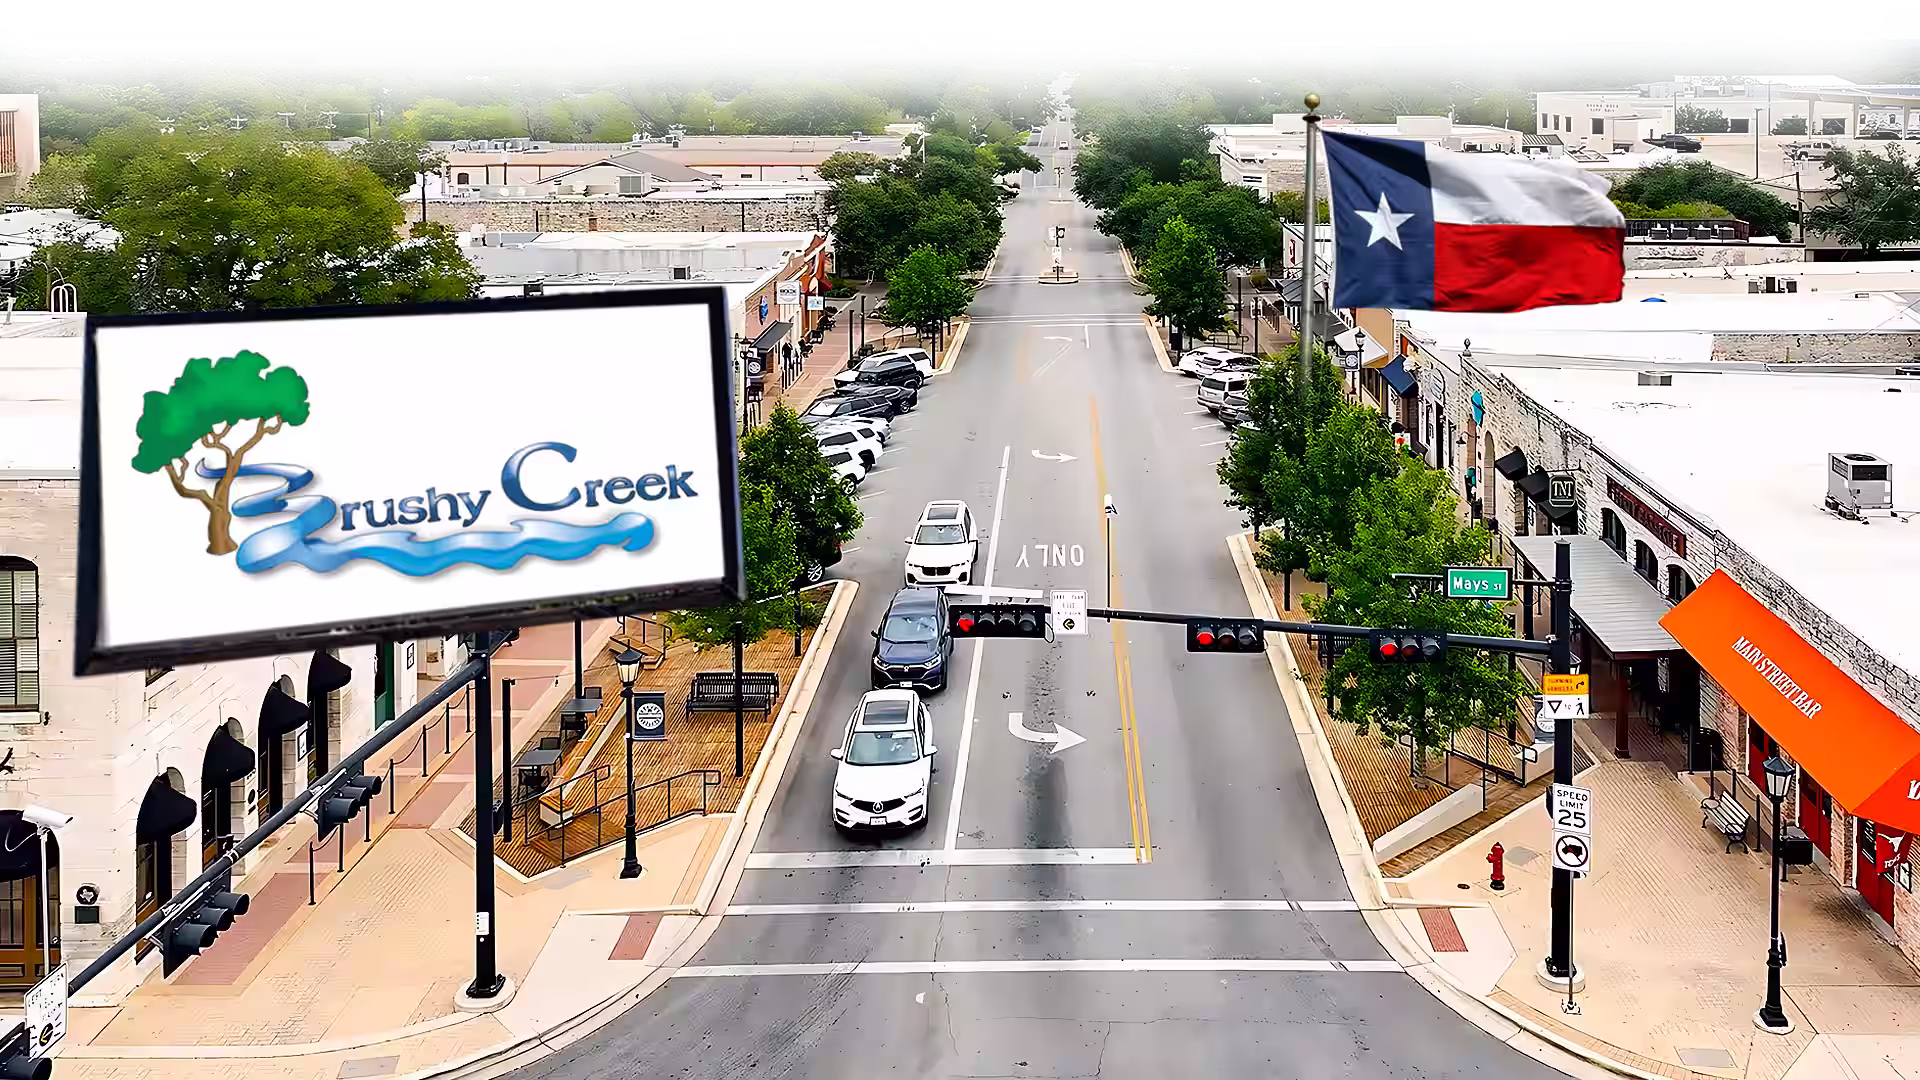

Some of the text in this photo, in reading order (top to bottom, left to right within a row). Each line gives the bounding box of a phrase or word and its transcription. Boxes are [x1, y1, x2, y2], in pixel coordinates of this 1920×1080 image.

[1552, 480, 1573, 498] TNT
[198, 441, 698, 575] Brushy Creek
[1015, 543, 1085, 568] ONLY
[1453, 576, 1502, 592] Mays ST
[1731, 635, 1823, 719] MAIN STREET BAR
[1556, 789, 1588, 802] SPEED
[1559, 799, 1584, 810] LIMIT
[1558, 809, 1587, 828] 25
